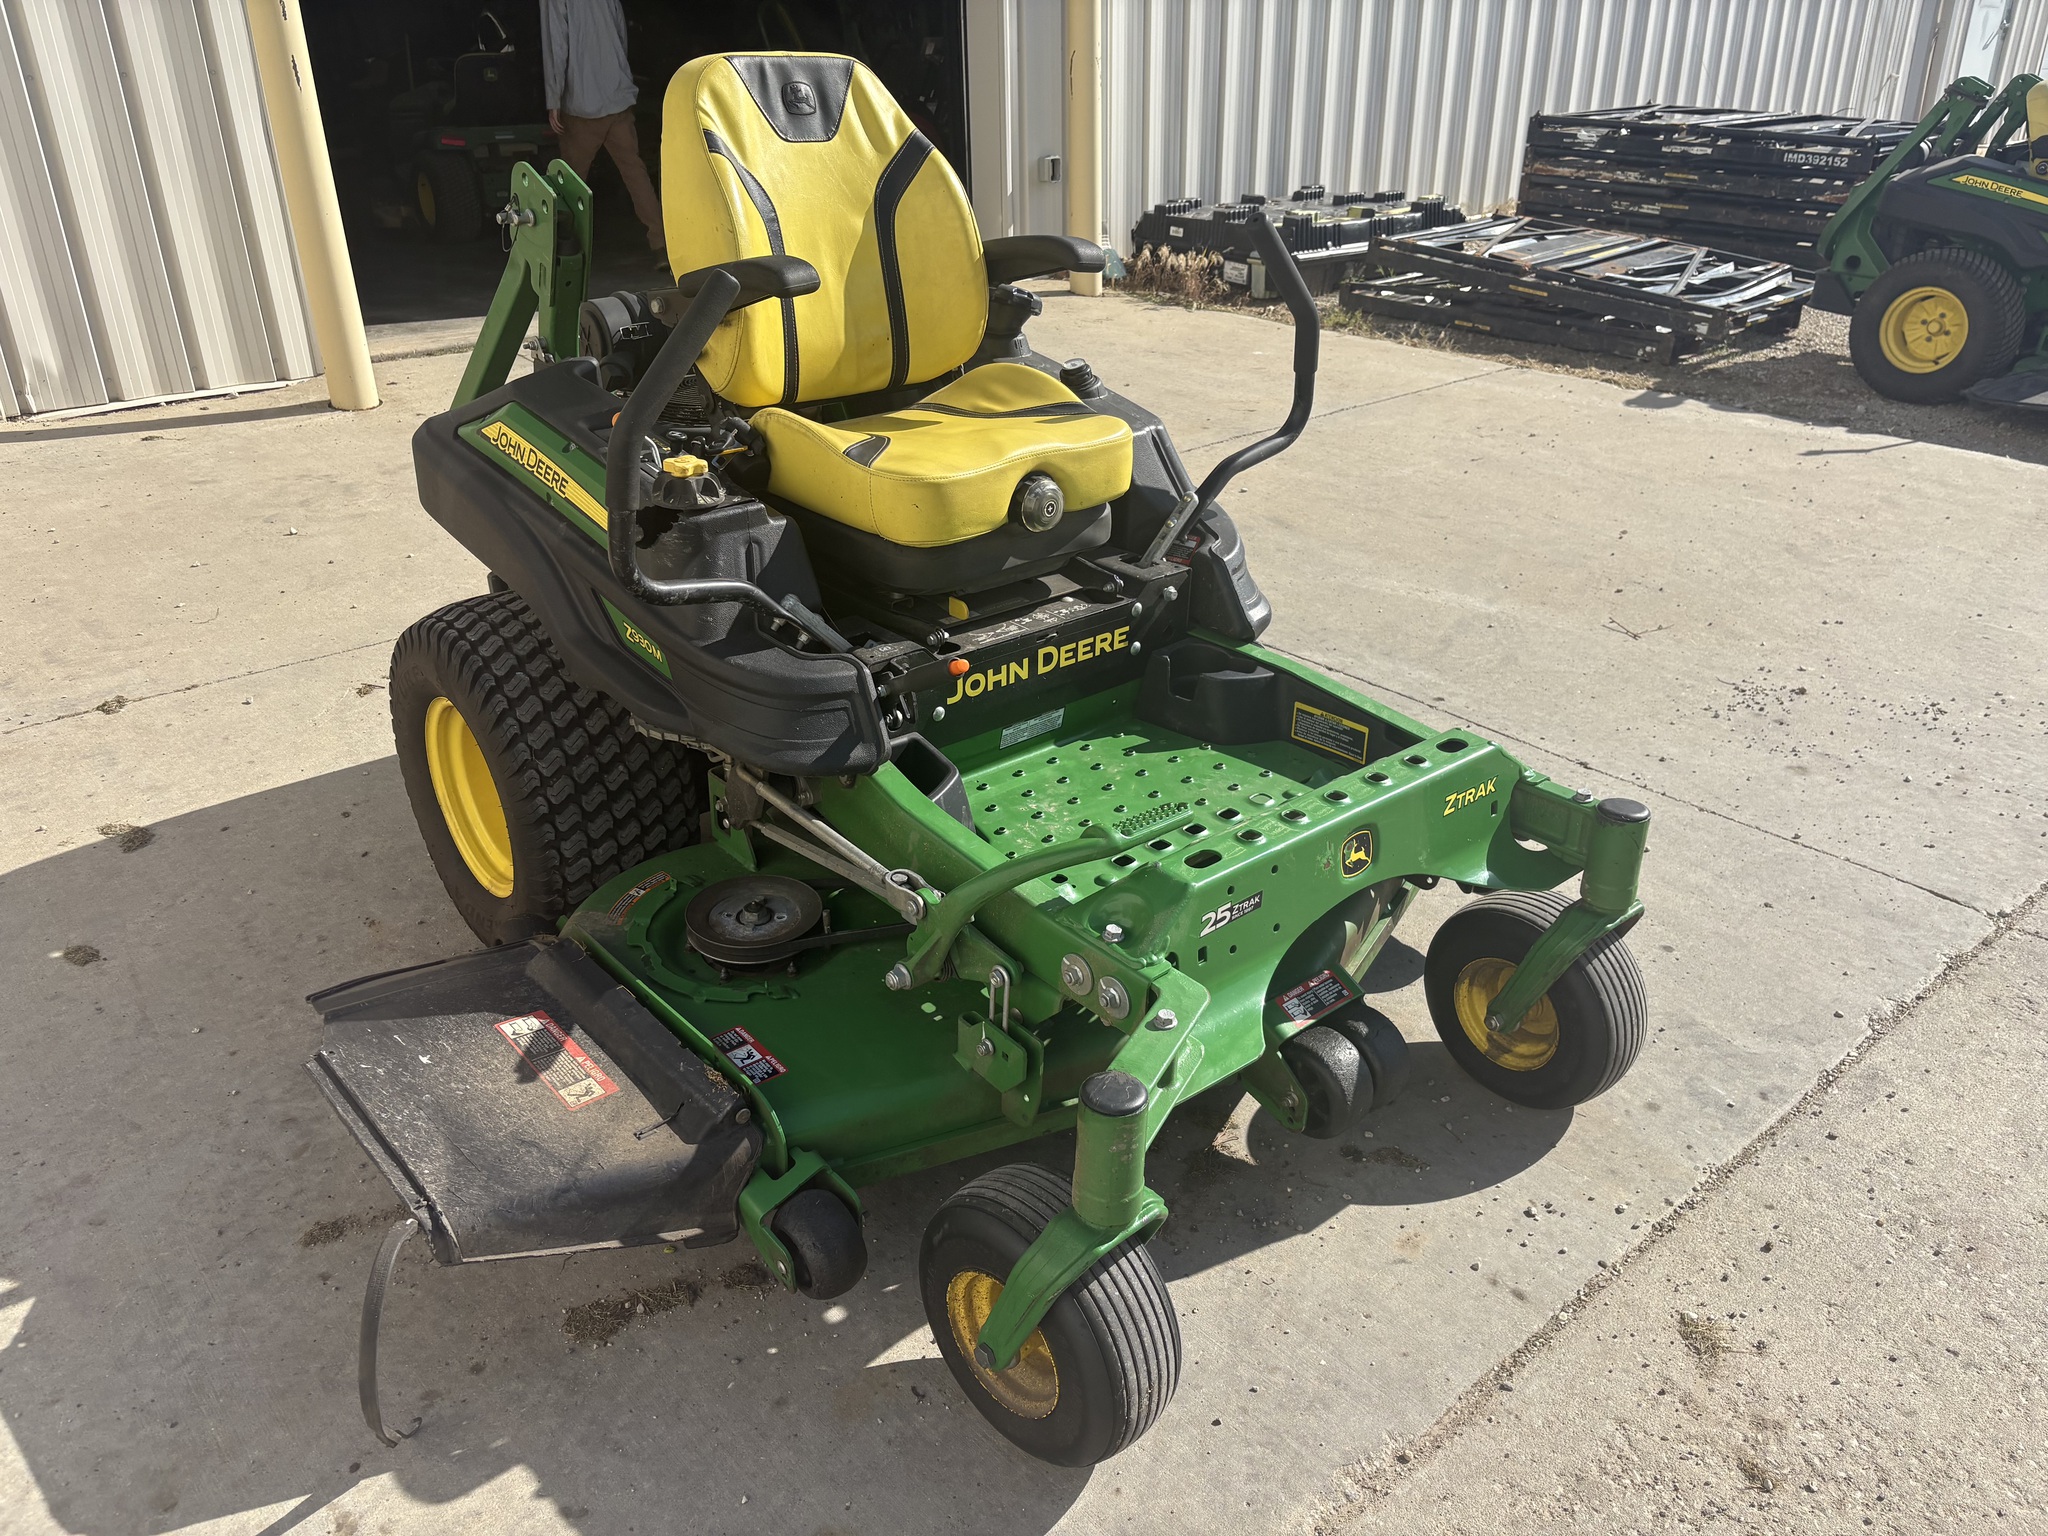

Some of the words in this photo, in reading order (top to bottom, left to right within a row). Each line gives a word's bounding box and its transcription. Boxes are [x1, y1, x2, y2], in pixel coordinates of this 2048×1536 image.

[1783, 152, 1849, 168] IMD392152
[1962, 176, 1990, 188] JOHN
[1990, 182, 2024, 197] DEERE
[492, 426, 526, 462] JOHN
[526, 447, 569, 496] DEERE
[623, 622, 663, 663] Z930M
[946, 657, 1029, 705] JOHN
[1037, 625, 1130, 675] DEERE
[1443, 776, 1498, 817] ZTRAK
[1200, 902, 1232, 938] 25
[1232, 894, 1261, 916] ZTRAK
[545, 1022, 568, 1042] DANGER
[581, 1060, 606, 1082] PELIGRO
